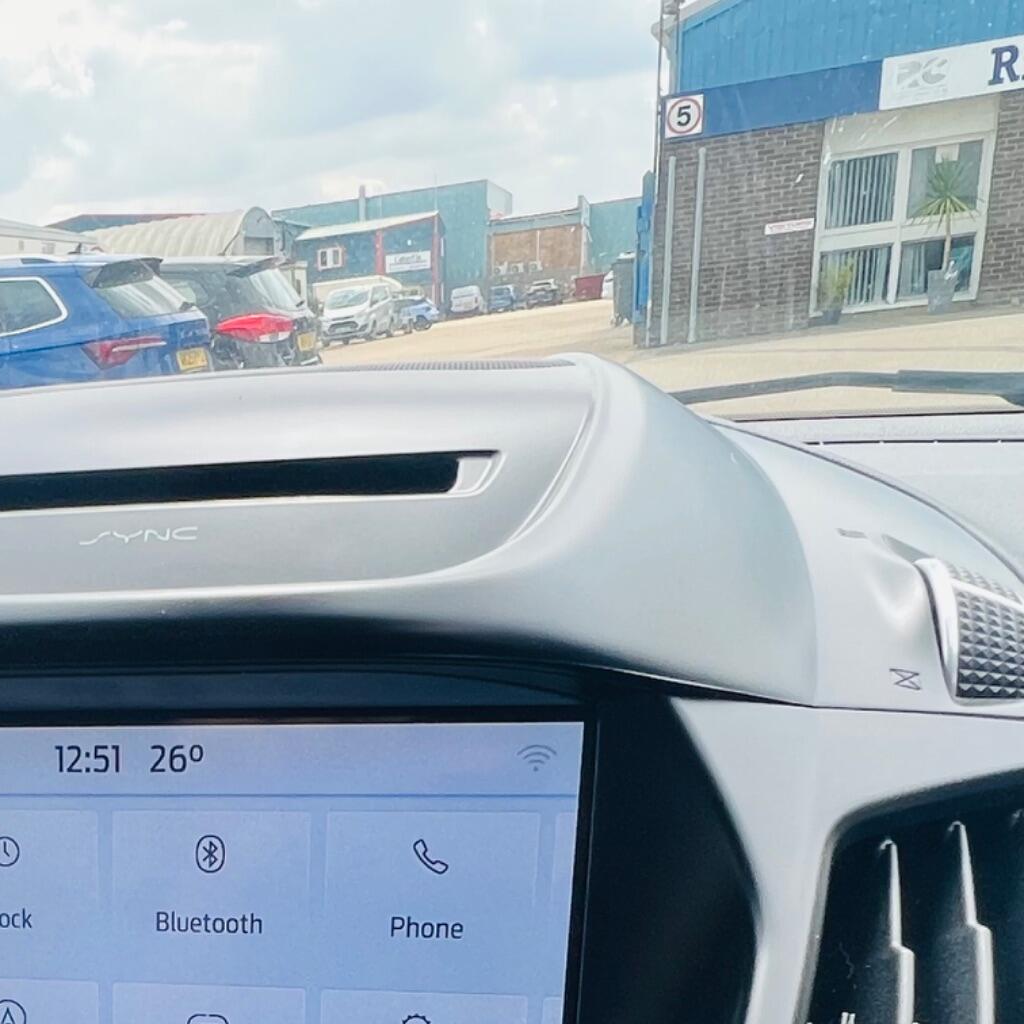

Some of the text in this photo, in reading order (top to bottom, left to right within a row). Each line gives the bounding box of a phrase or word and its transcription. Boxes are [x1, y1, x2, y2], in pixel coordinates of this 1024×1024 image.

[676, 105, 692, 127] 5
[79, 526, 198, 546] SYNC
[55, 745, 121, 774] 12:51
[155, 911, 263, 935] Bluetooth
[390, 916, 464, 940] Phone
